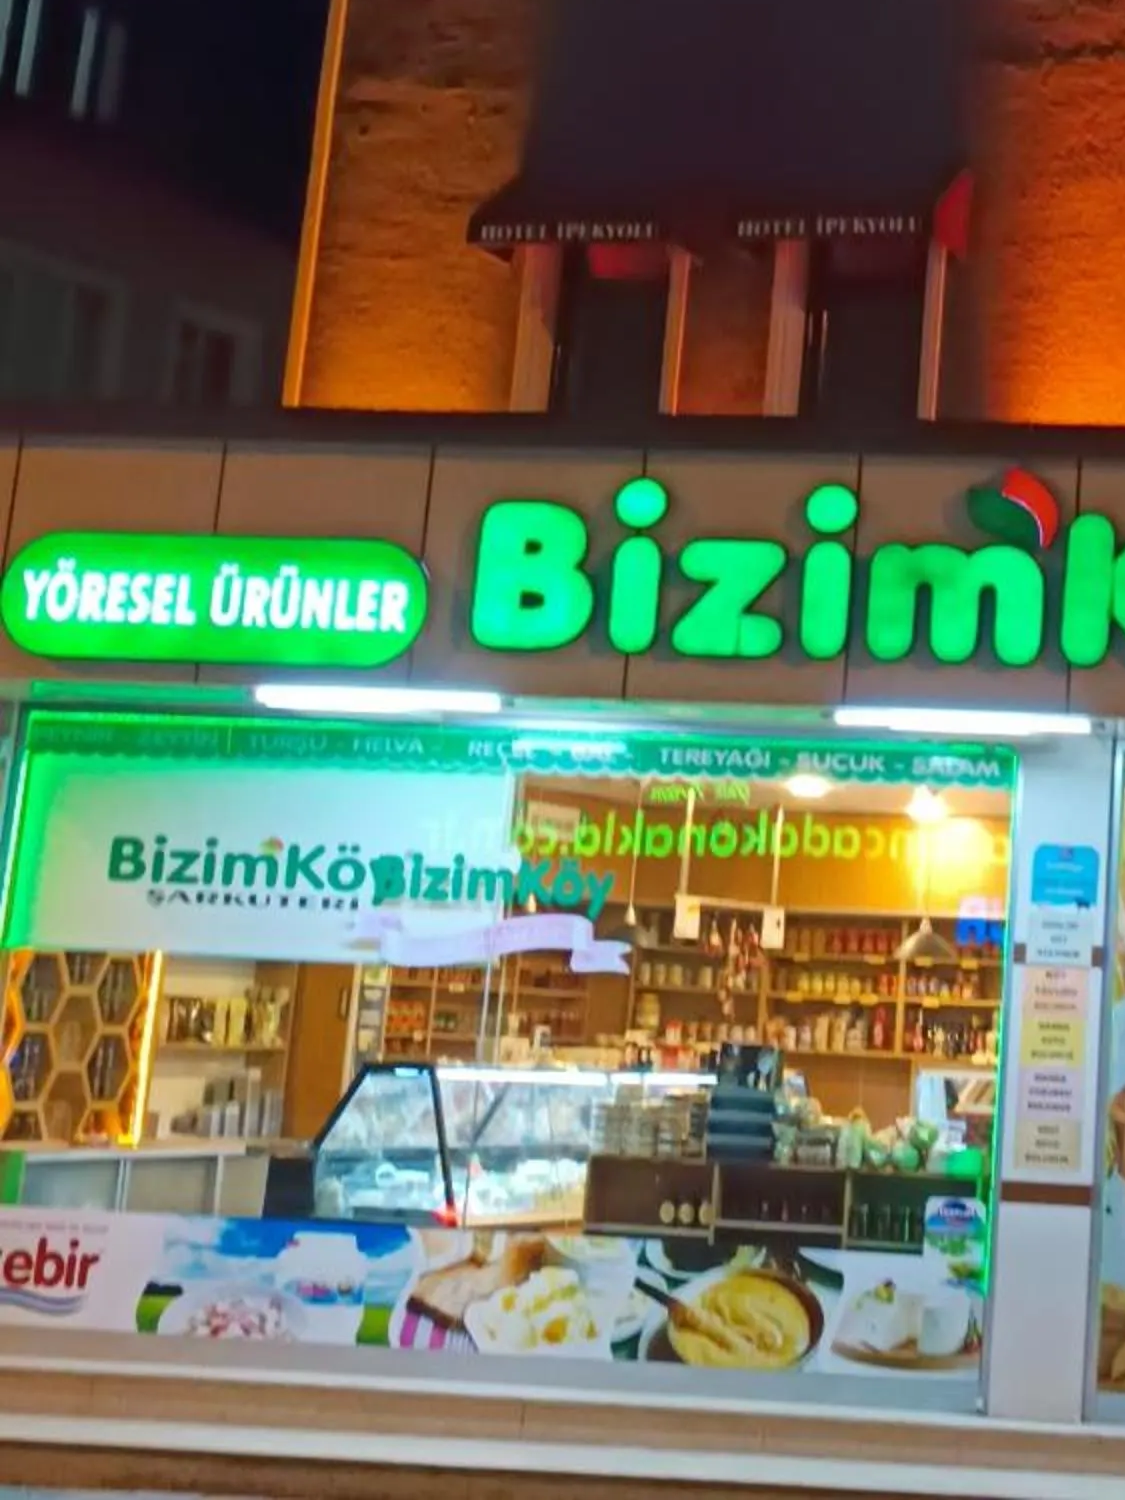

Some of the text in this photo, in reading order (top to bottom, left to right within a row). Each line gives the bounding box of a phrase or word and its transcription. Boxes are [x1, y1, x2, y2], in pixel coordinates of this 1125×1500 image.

[22, 556, 409, 633] YÖRESEL ÜRÜNLER
[659, 744, 772, 770] TEREYAĞI
[796, 750, 886, 773] SUCUK
[0, 1237, 100, 1288] ebir
